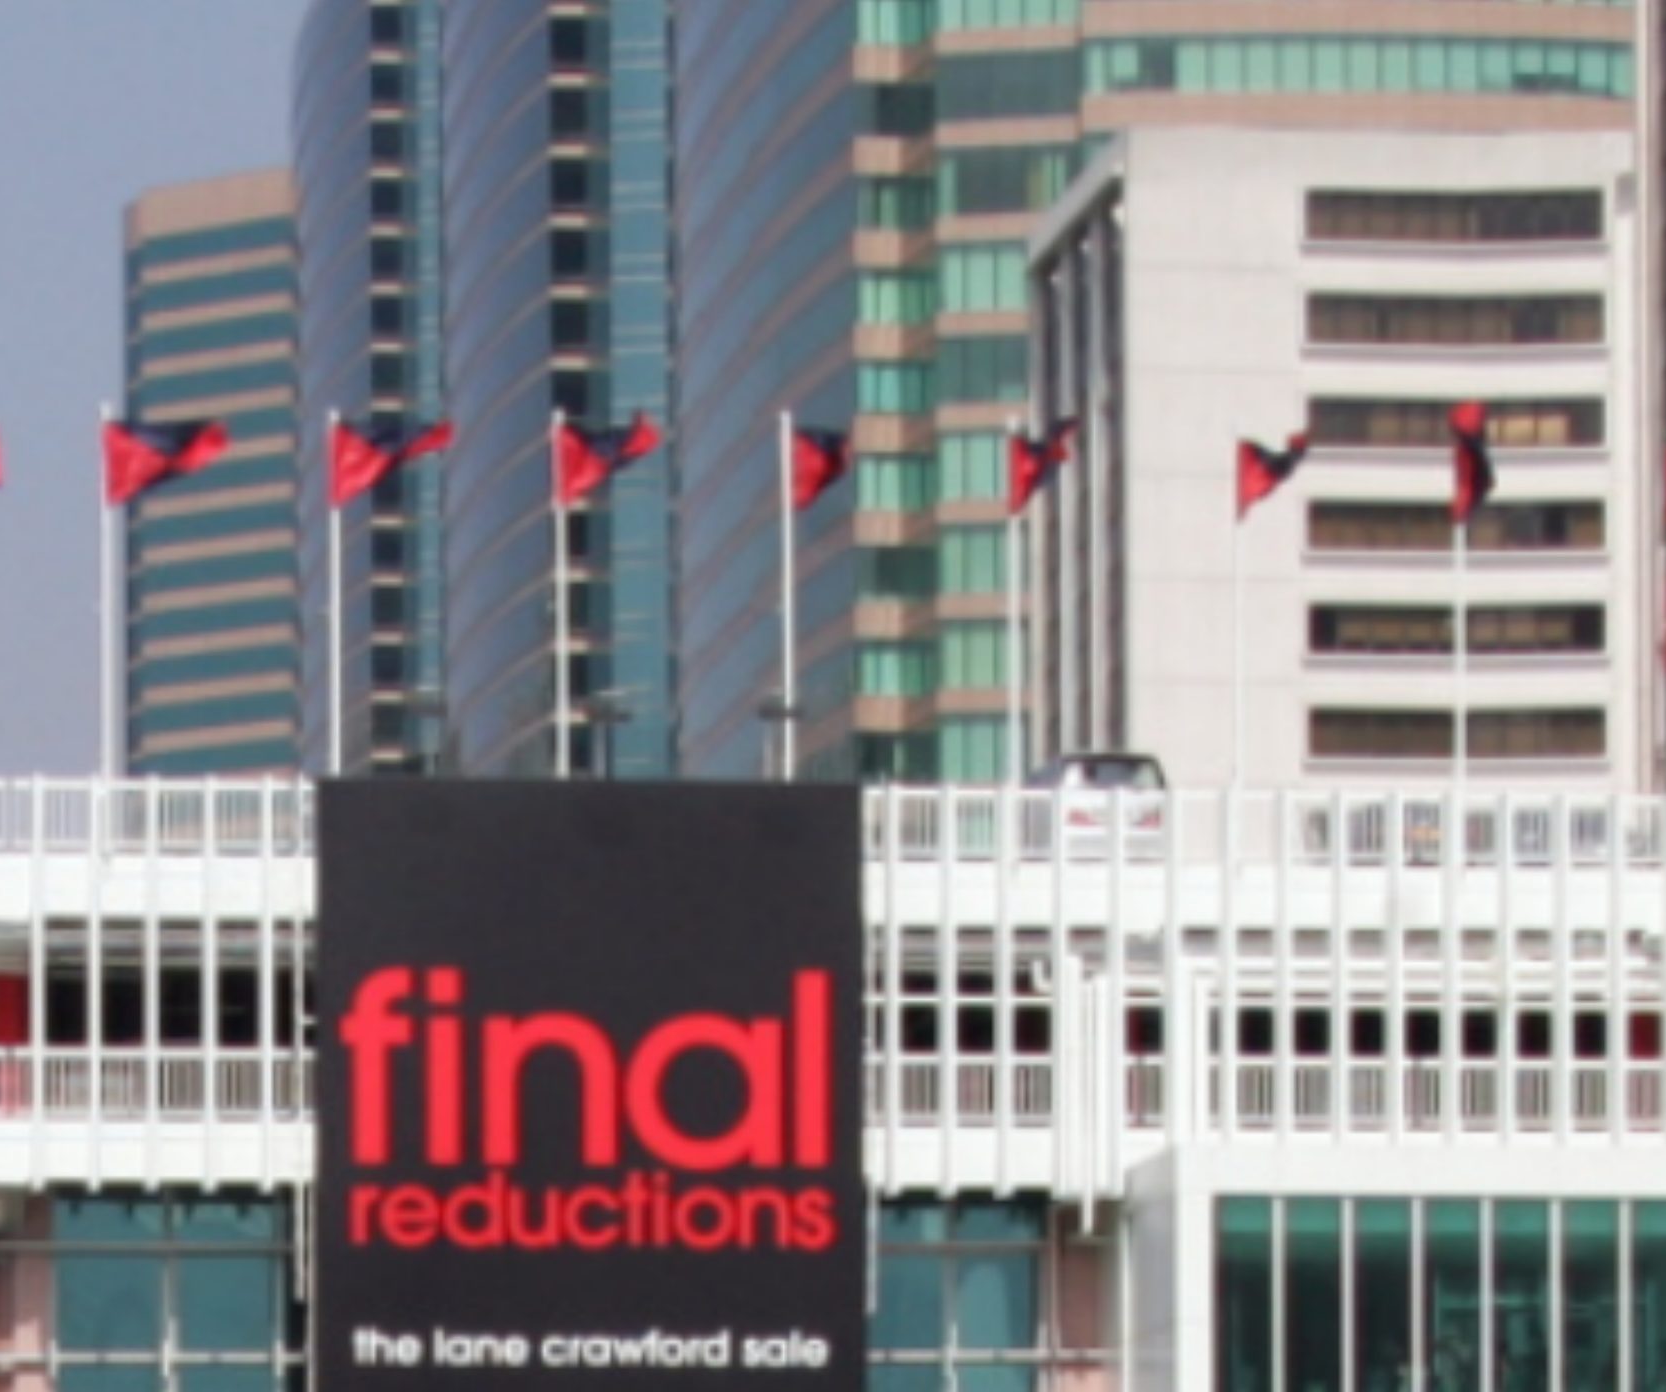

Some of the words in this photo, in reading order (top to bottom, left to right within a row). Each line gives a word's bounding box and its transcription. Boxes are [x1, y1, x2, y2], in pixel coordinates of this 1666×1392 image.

[340, 967, 831, 1171] final
[348, 1172, 838, 1251] reductions
[353, 1329, 422, 1366] the
[433, 1330, 530, 1366] lane
[541, 1330, 731, 1367] crawford
[742, 1331, 829, 1367] sale
